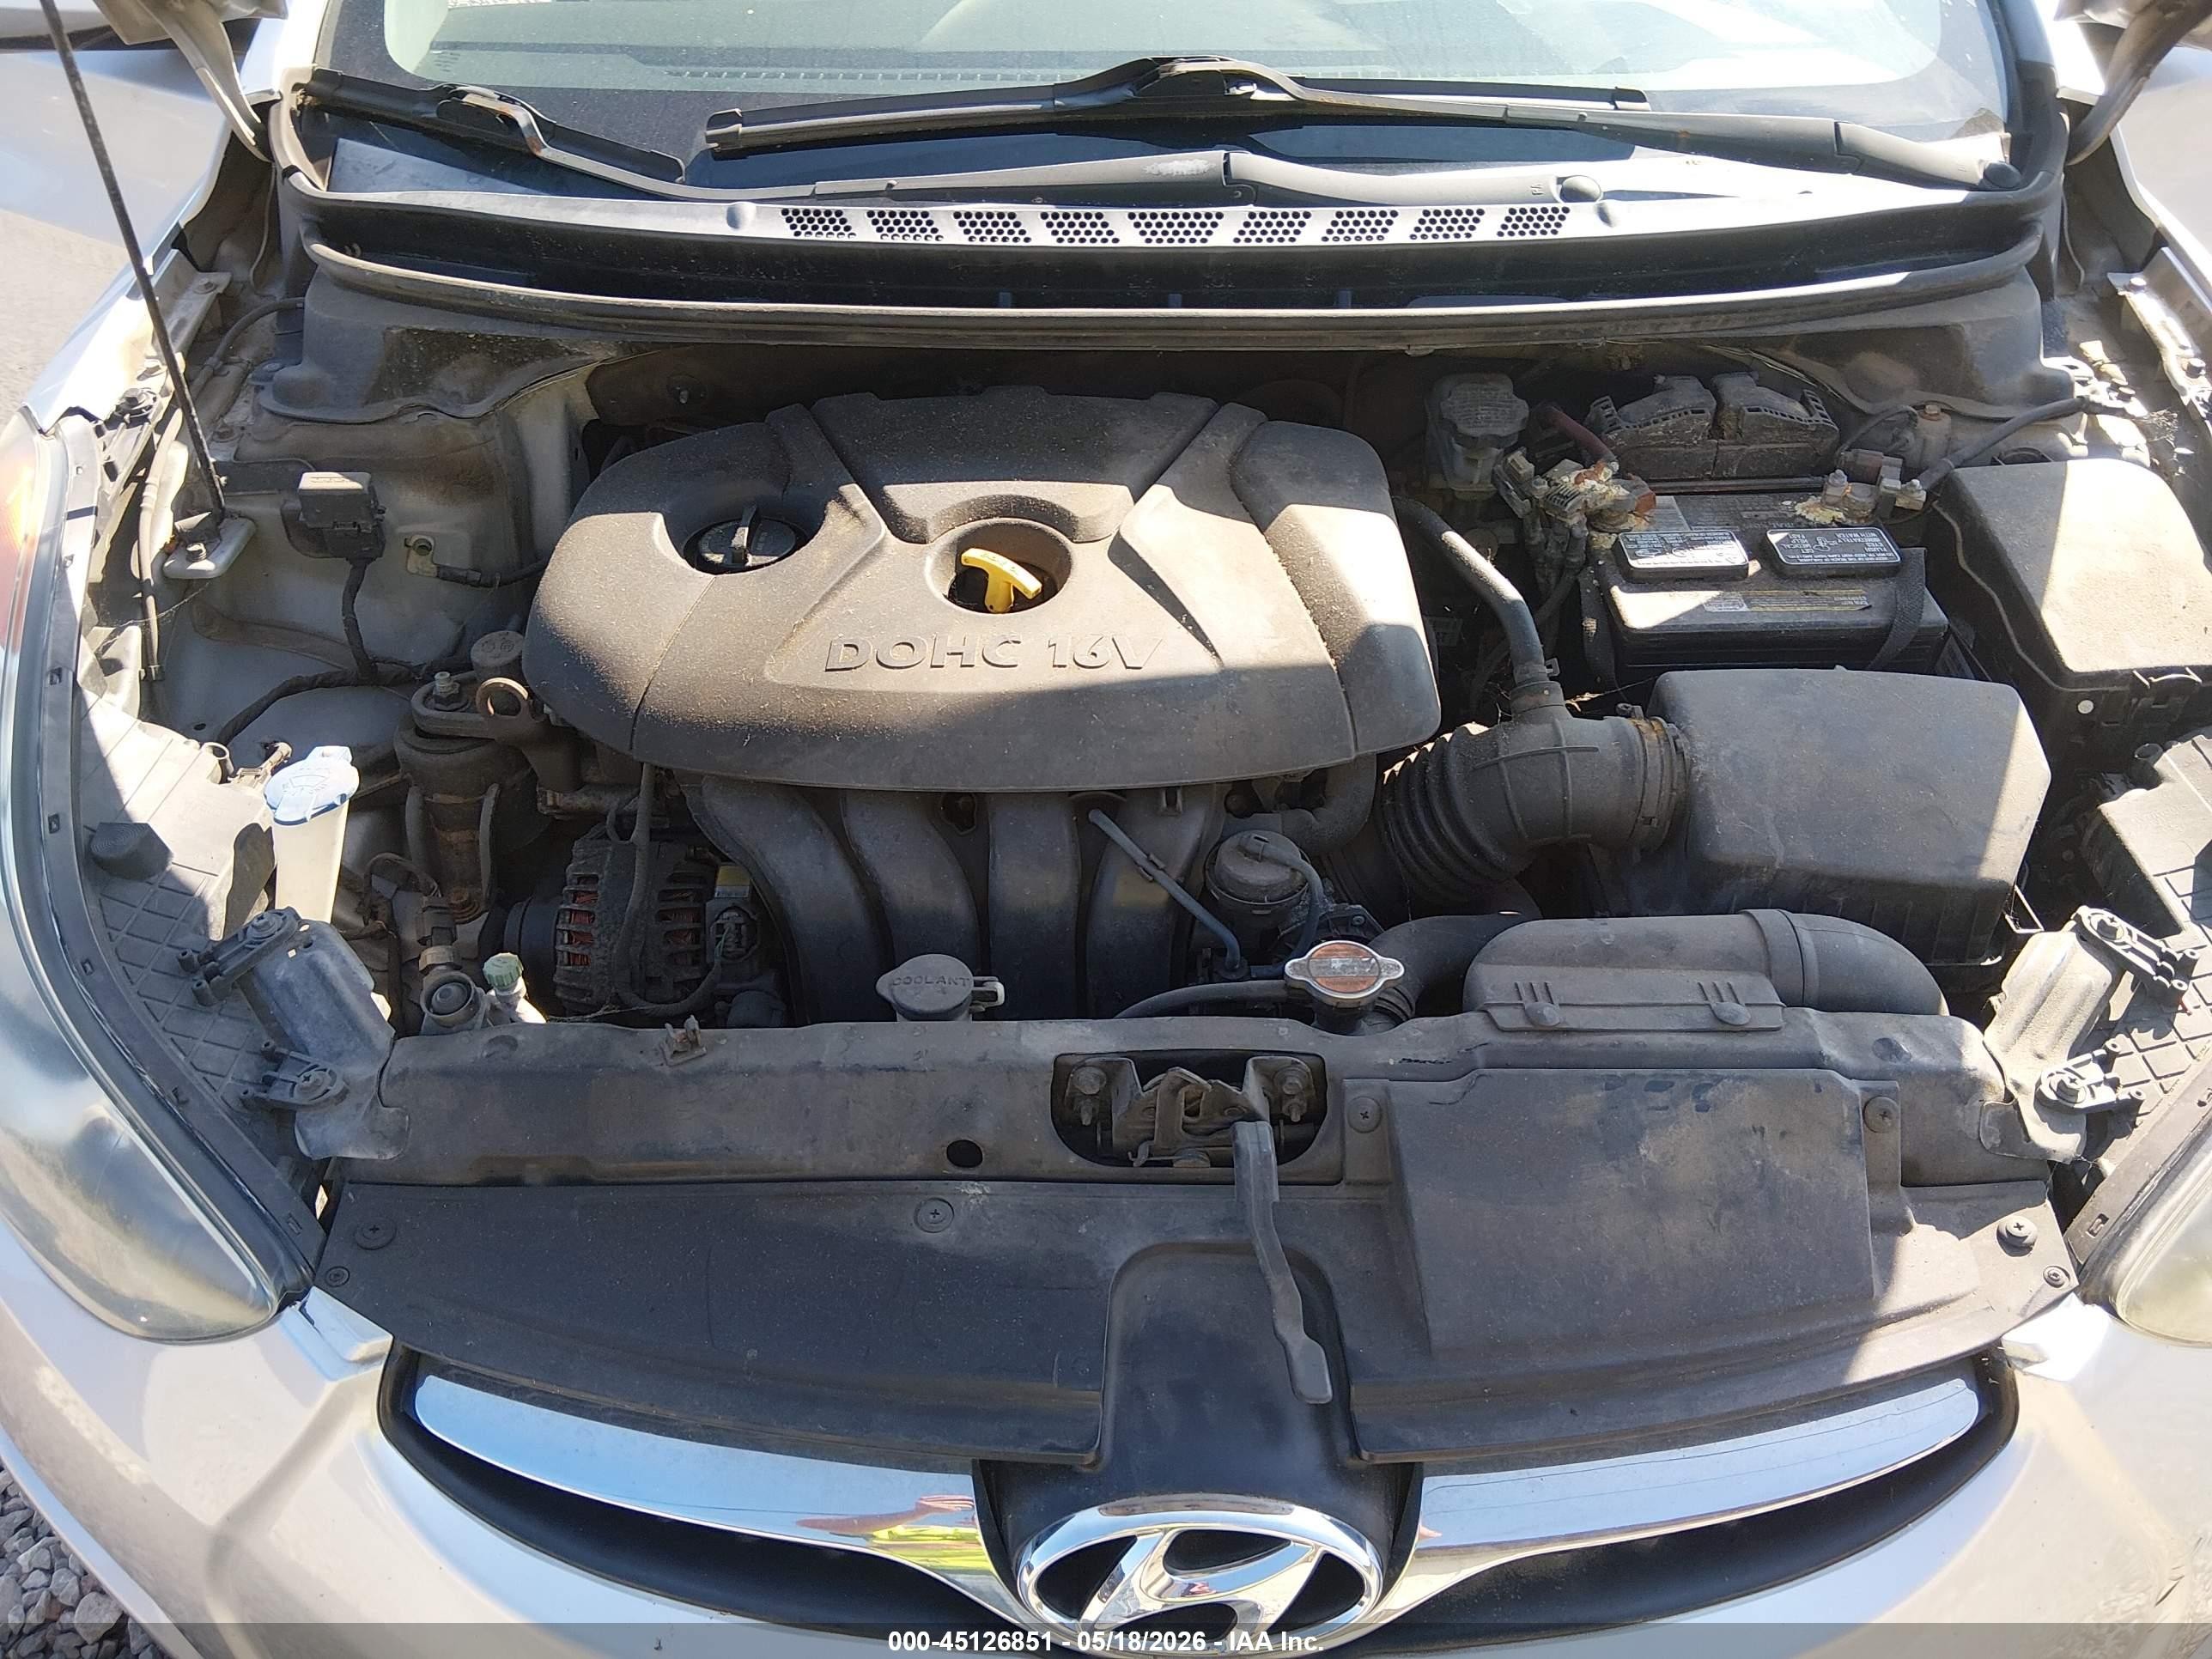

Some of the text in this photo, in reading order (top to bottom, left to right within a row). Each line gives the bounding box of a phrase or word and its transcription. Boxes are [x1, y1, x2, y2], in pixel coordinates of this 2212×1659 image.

[824, 633, 1164, 672] DOHC 16V
[891, 975, 972, 987] COOLANT
